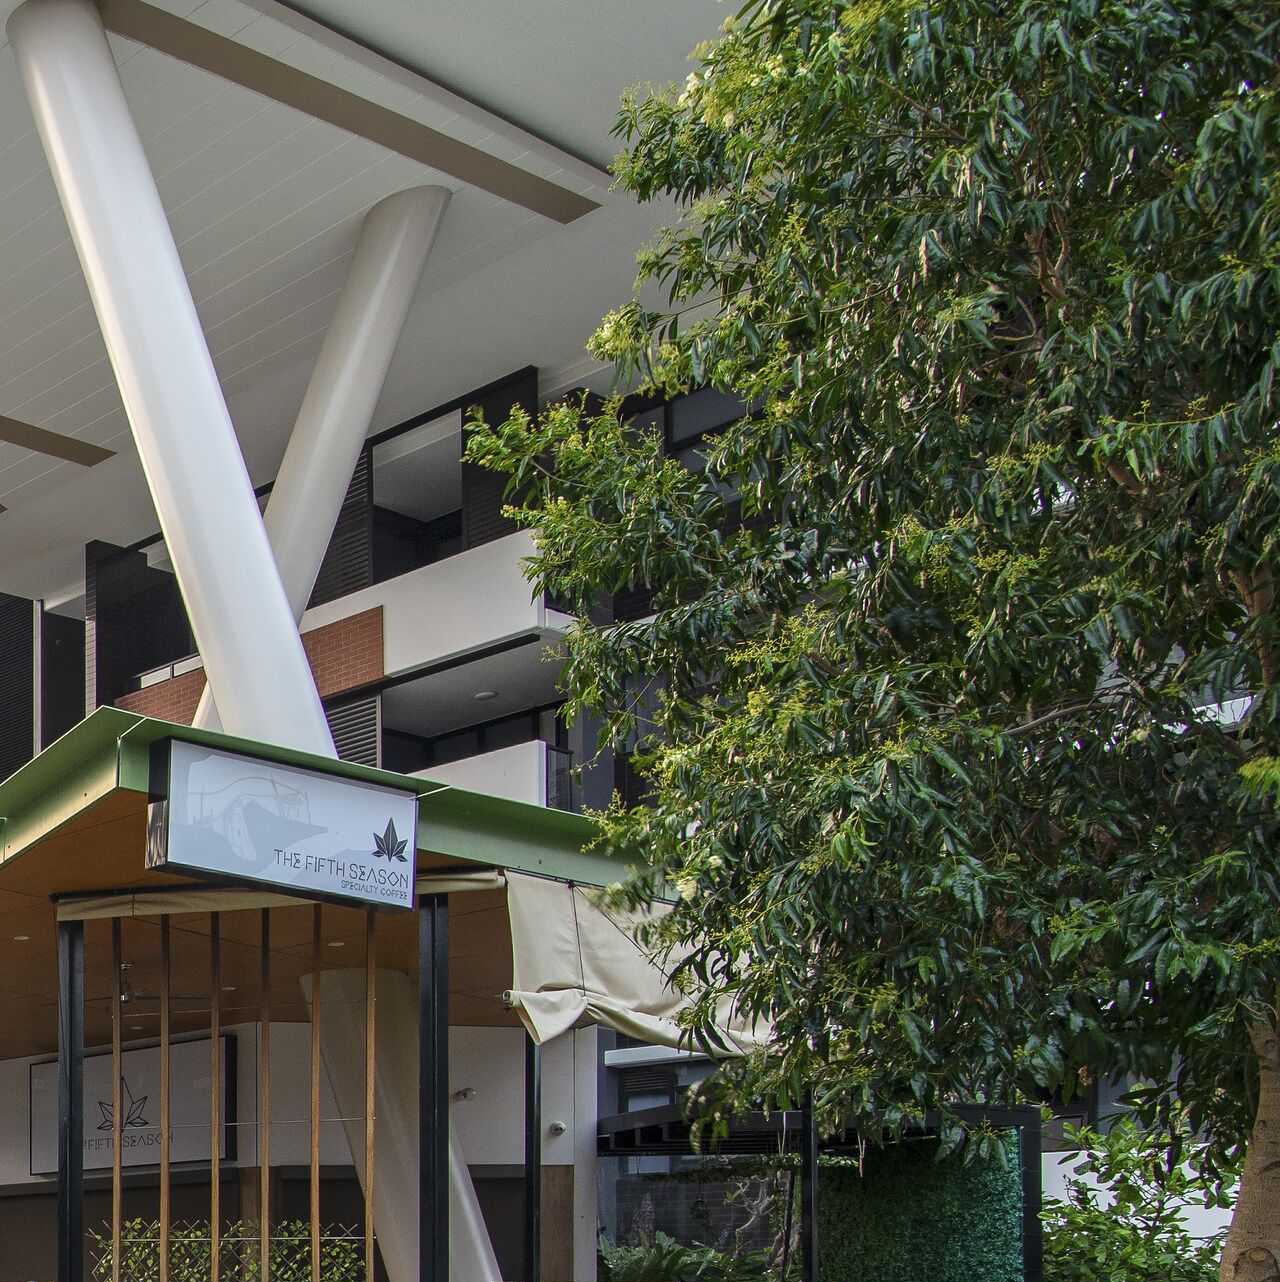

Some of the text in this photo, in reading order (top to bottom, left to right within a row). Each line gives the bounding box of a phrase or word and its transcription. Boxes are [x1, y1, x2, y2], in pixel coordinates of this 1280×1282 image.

[273, 849, 409, 889] THE FIFTH SEASON
[341, 880, 408, 900] SPECIALTY COFFEE
